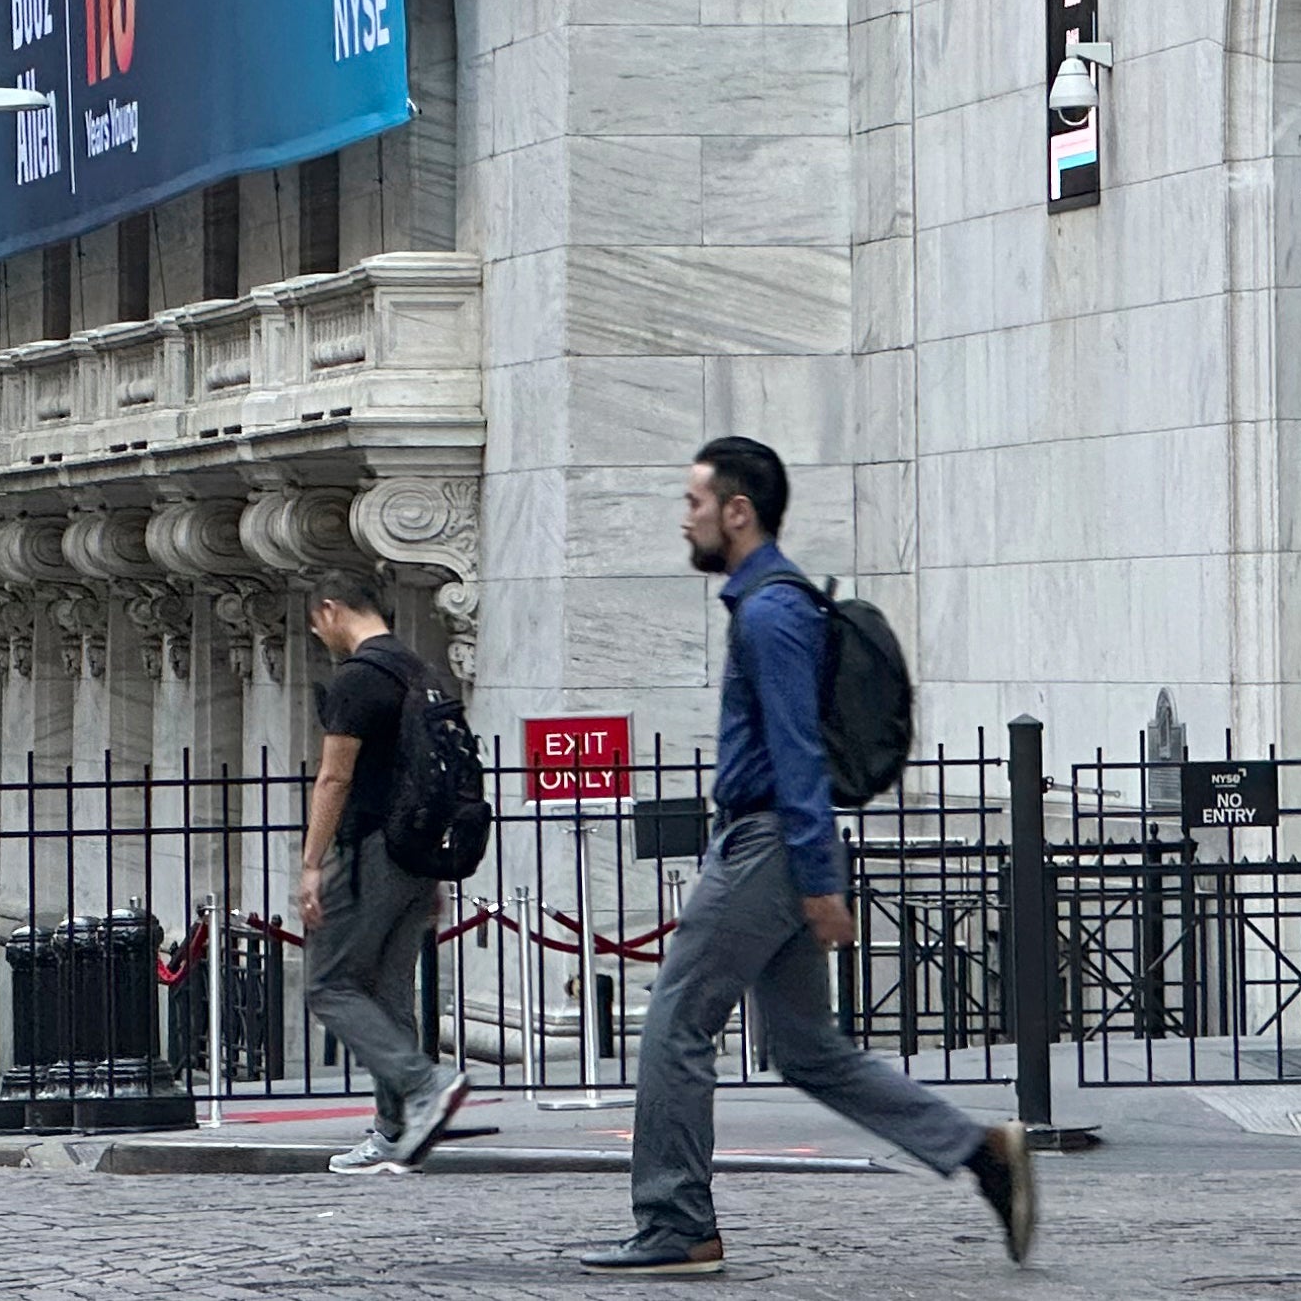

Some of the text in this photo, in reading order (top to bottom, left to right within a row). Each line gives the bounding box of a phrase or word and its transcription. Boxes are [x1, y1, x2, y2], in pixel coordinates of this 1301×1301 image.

[16, 68, 60, 186] Allen
[85, 97, 139, 158] Years Young
[545, 732, 608, 756] EXIT
[539, 767, 613, 790] ONLY
[1217, 793, 1242, 808] NO
[1202, 808, 1257, 823] ENTRY
